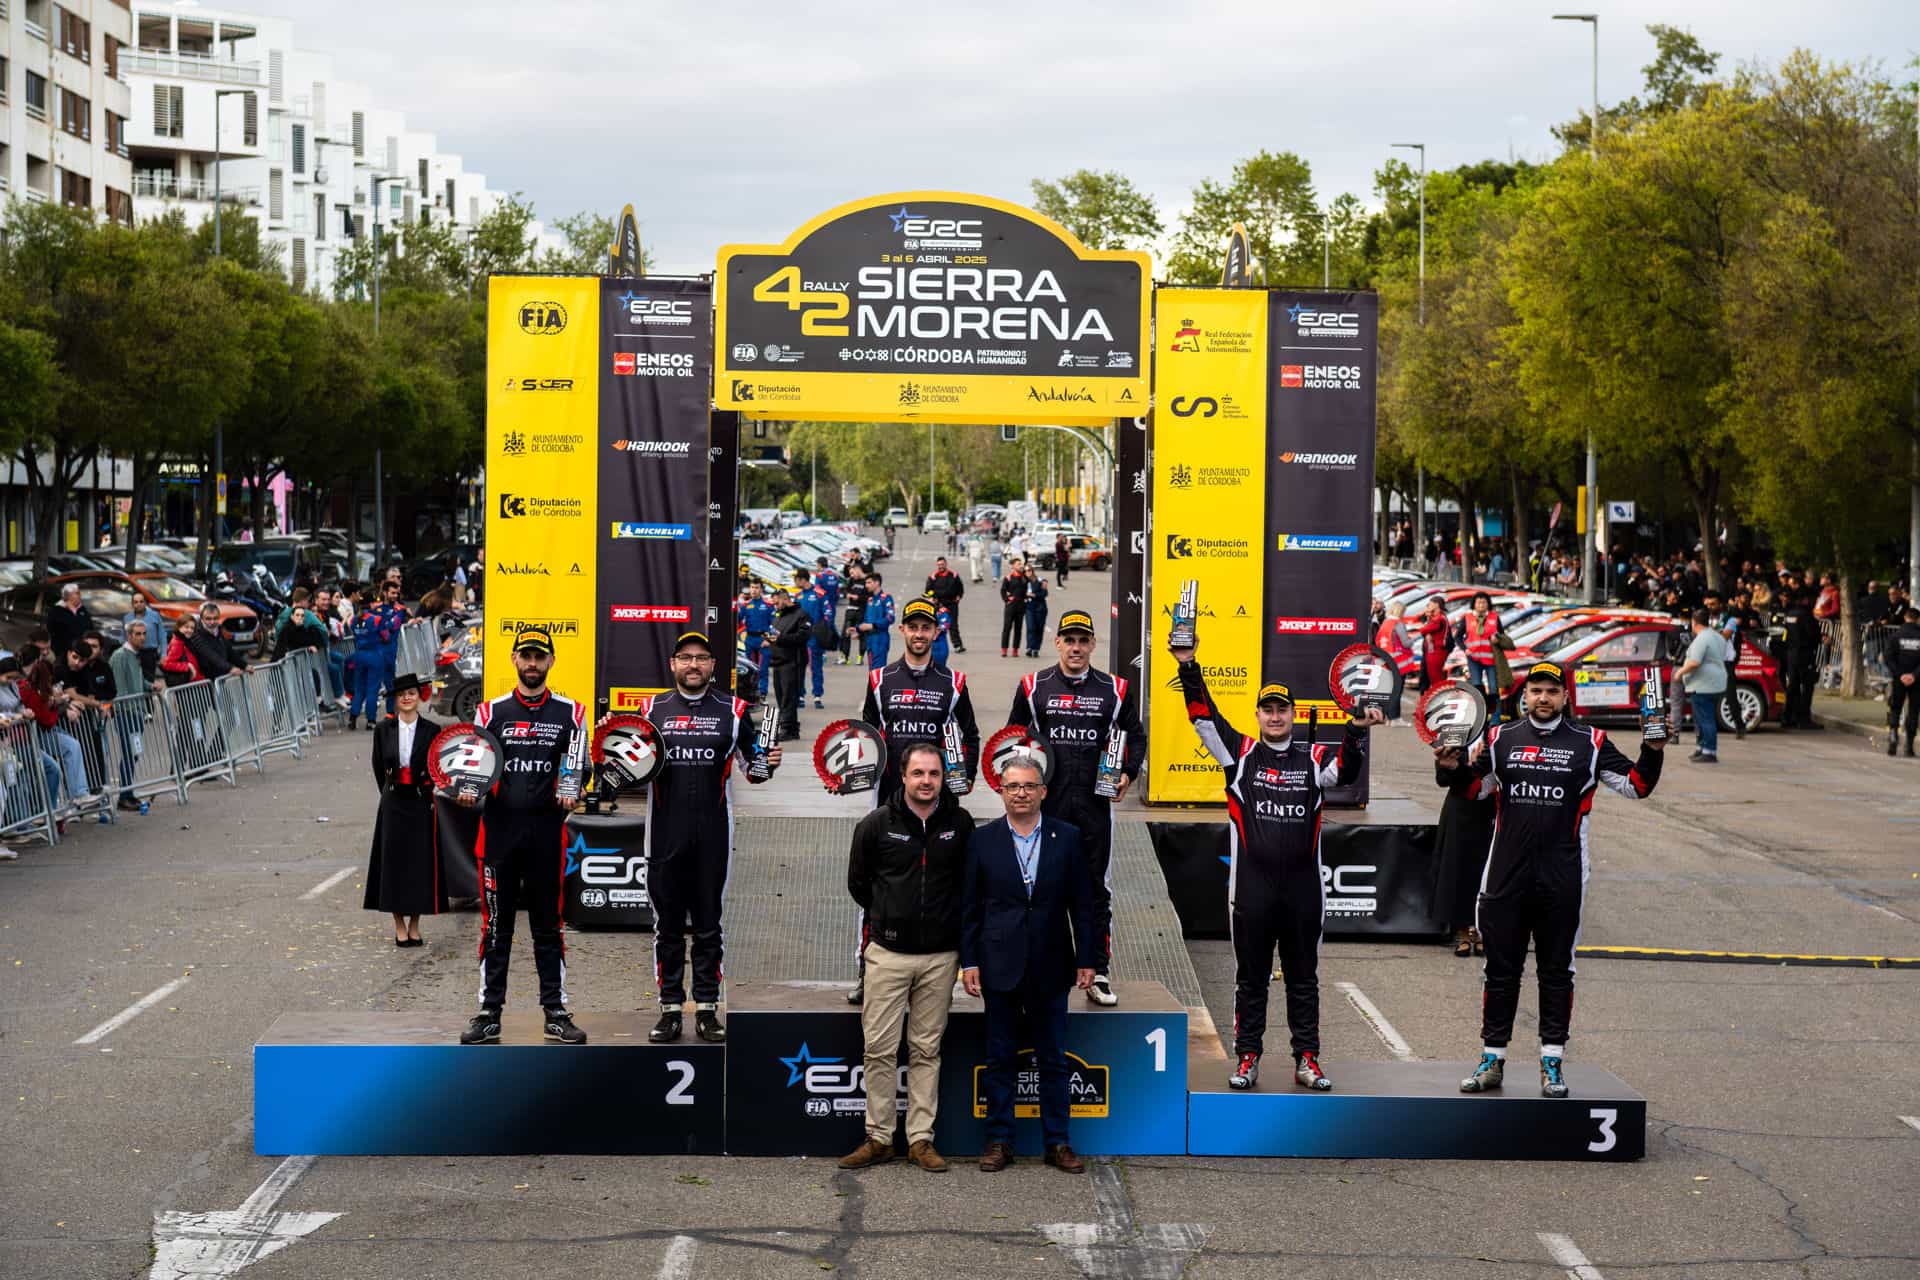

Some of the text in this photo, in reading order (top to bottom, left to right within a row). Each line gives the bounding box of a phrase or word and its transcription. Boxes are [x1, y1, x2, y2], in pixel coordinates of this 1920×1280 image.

[904, 219, 982, 238] ERC
[881, 254, 988, 264] 3 al 6 ABRIL 2025
[803, 281, 850, 292] RALLY
[858, 266, 1067, 303] SIERRA
[630, 300, 692, 315] ERC
[858, 305, 1114, 342] MORENA
[1298, 312, 1359, 327] ERC
[637, 353, 694, 367] ENEOS
[894, 346, 975, 364] CÓRDOBA
[977, 357, 1027, 366] HUMANIDAD
[637, 367, 694, 377] MOTOR OIL
[1304, 365, 1360, 379] ENEOS
[758, 385, 801, 394] Diputación
[1304, 379, 1360, 389] MOTOR OIL
[1028, 386, 1096, 403] Andalucía
[532, 434, 583, 444] AYUNTAMIENTO
[532, 443, 575, 453] DE CÓRDOBA
[1198, 467, 1250, 477] AYUNTAMIENTO
[1198, 476, 1241, 486] DE CÓRDOBA
[530, 497, 581, 509] Diputación
[530, 508, 581, 517] de Córdoba
[634, 527, 685, 536] MICHELIN
[1196, 538, 1248, 549] Diputación
[1301, 539, 1351, 548] MICHELIN
[1196, 548, 1248, 558] de Córdoba
[613, 608, 688, 619] MRF TYRES
[1280, 620, 1354, 631] MRF TYRES
[1202, 666, 1248, 678] EGASUS
[1220, 679, 1247, 688] GROUP
[890, 694, 914, 703] GR
[1048, 699, 1072, 708] GR
[663, 720, 688, 729] GR
[503, 727, 528, 737] GR
[1510, 751, 1537, 761] GR
[1168, 763, 1224, 773] ATRESVE
[1256, 770, 1278, 783] GR
[1145, 1027, 1167, 1072] 1
[665, 1060, 696, 1105] 2
[1017, 1071, 1083, 1083] SIEA
[1017, 1083, 1097, 1095] MONA
[1587, 1108, 1618, 1153] 3
